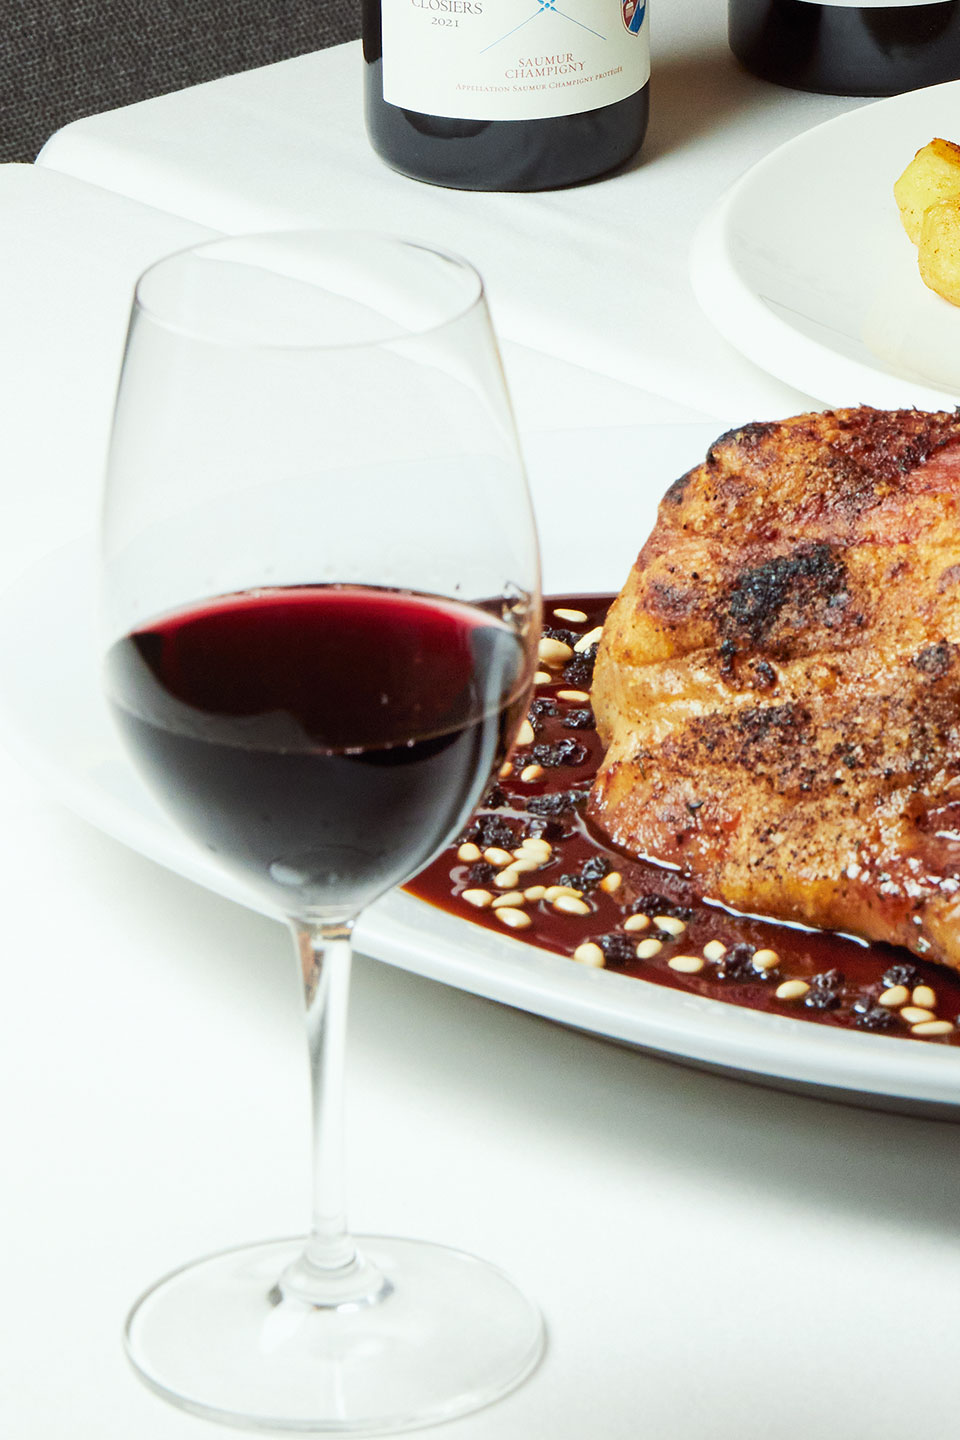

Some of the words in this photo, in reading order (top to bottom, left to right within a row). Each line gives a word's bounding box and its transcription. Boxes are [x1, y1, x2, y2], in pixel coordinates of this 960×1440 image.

[431, 16, 460, 28] 2021
[518, 52, 574, 68] SAUMUR
[504, 61, 586, 79] CHAMPIGNY
